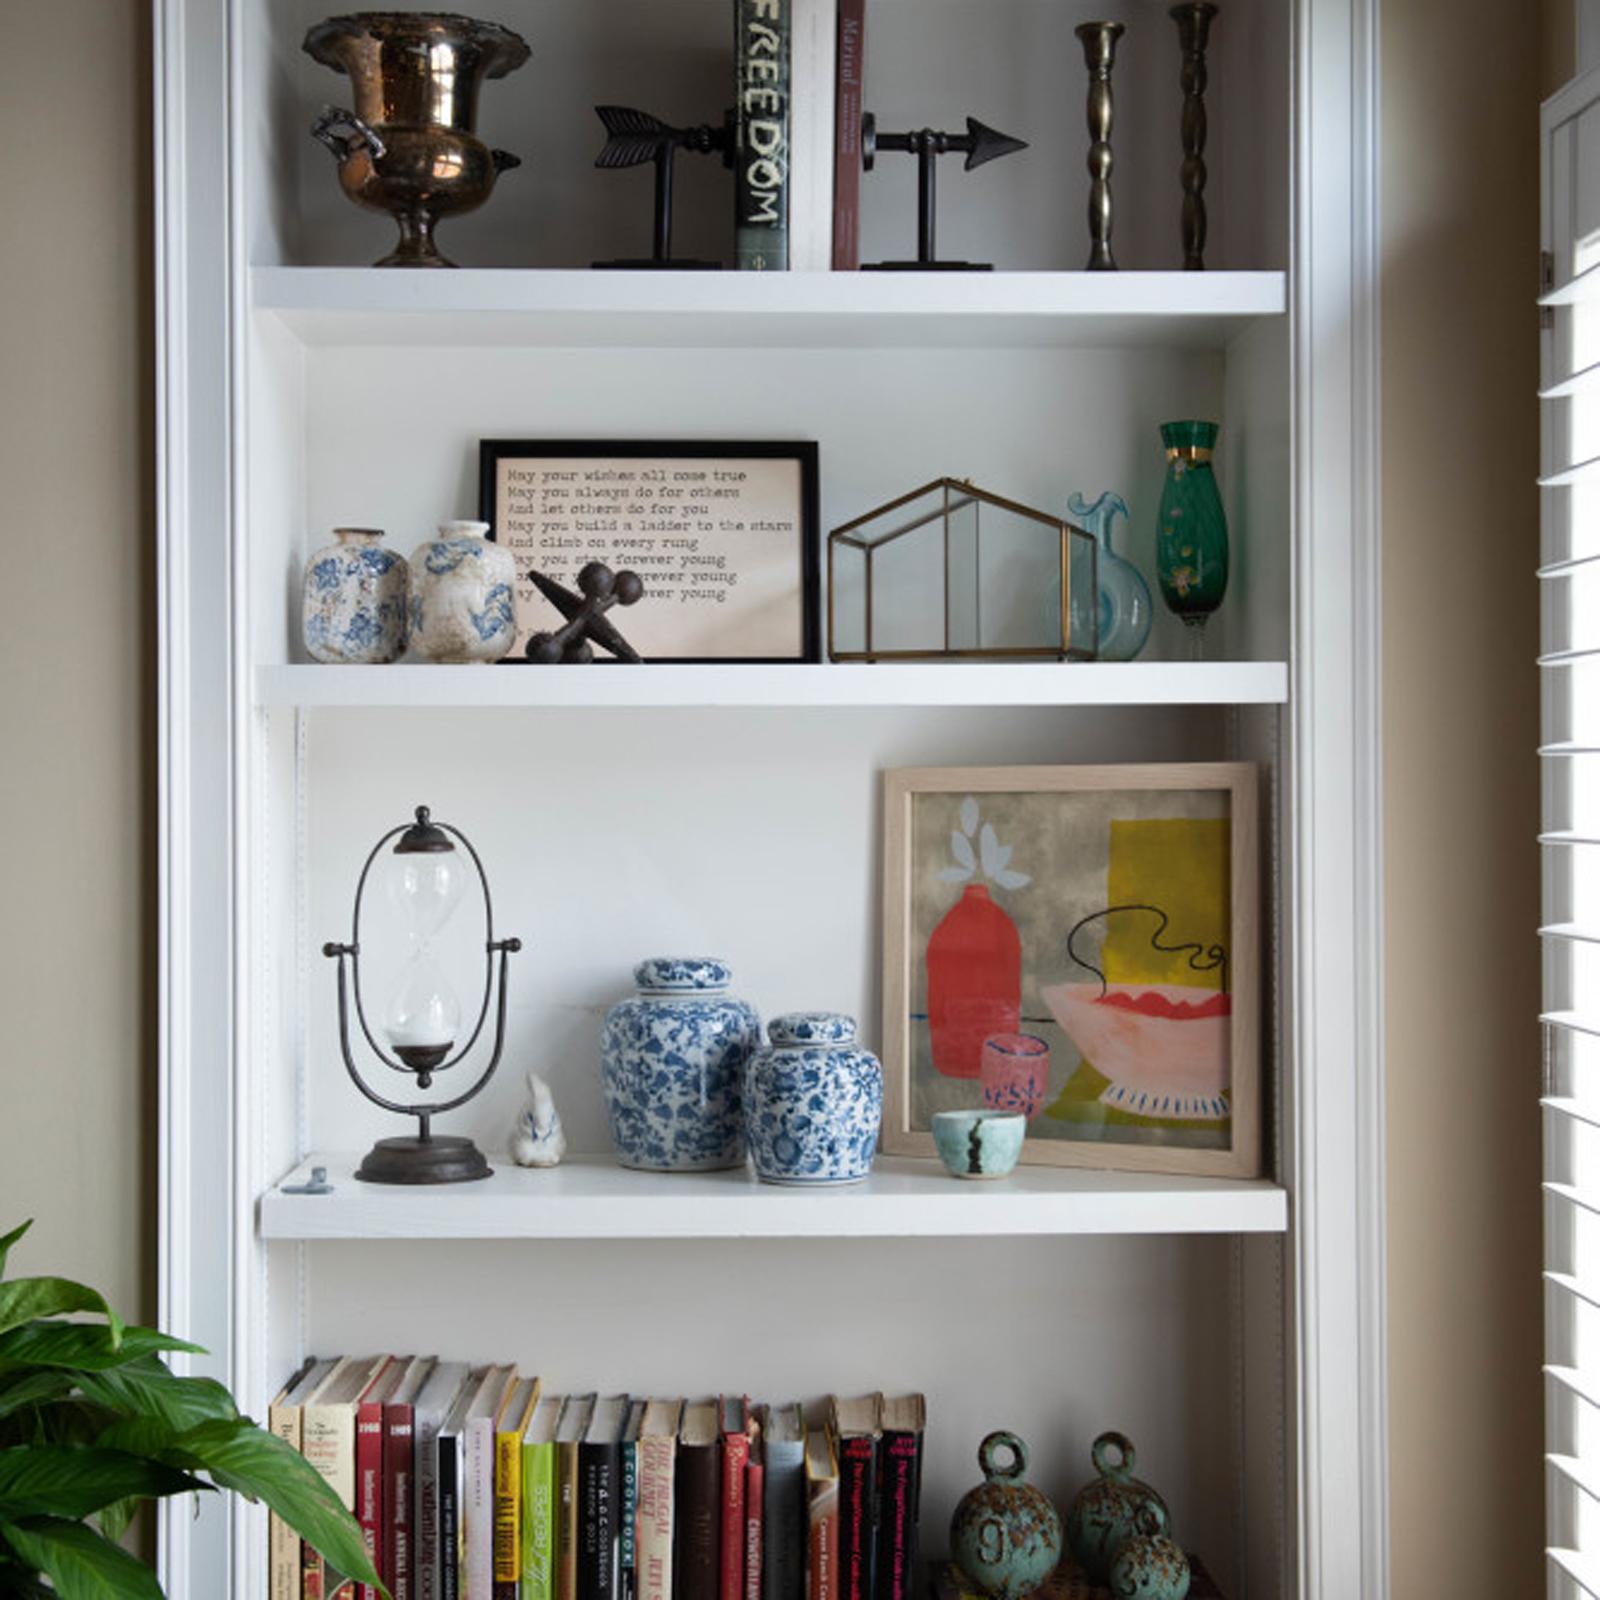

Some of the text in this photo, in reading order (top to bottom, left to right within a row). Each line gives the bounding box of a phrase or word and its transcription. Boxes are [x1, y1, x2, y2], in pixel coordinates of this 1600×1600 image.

[745, 0, 782, 222] FREEDOM
[508, 470, 747, 484] May your wishes all come true
[508, 487, 740, 500] May you always do for others
[508, 503, 709, 518] And let others do for you
[508, 520, 793, 534] May you build a ladder to the stars
[508, 537, 698, 552] And climb on every rung
[514, 556, 535, 567] ay
[541, 556, 568, 567] you
[616, 554, 675, 564] forever
[680, 556, 726, 569] young
[637, 572, 684, 581] orever
[691, 573, 737, 586] young
[680, 589, 726, 602] young
[655, 1475, 670, 1538] FRUGAL
[977, 1518, 1005, 1564] 9
